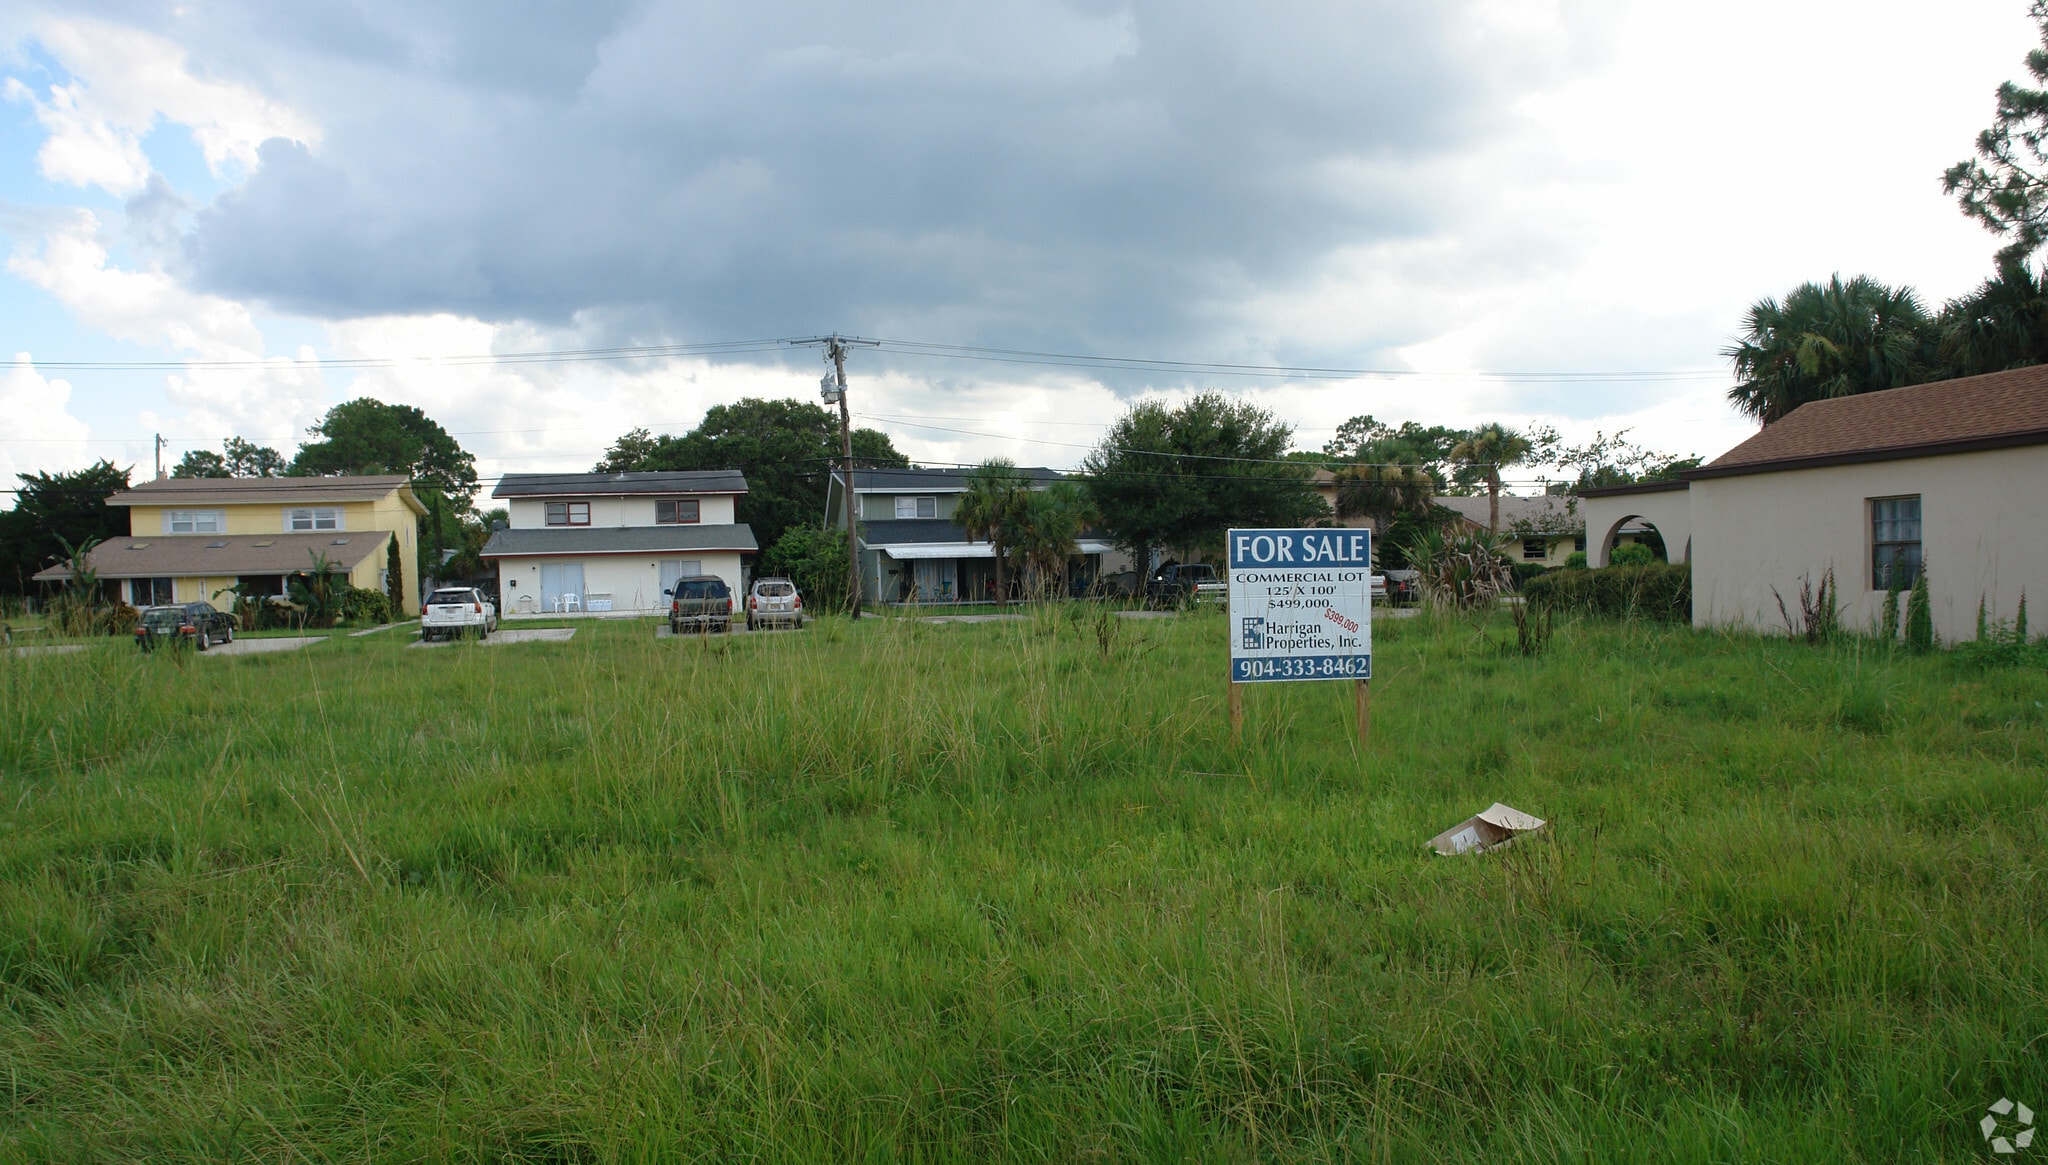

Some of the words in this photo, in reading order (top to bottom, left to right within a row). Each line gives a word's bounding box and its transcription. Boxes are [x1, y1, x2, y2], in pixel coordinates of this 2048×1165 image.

[1236, 535, 1294, 562] FOR
[1302, 535, 1363, 562] SALE
[1236, 572, 1333, 583] COMMERCIAL
[1338, 572, 1365, 582] LOT
[1266, 586, 1293, 596] 125'
[1296, 586, 1305, 595] X
[1311, 585, 1337, 595] 100'
[1268, 599, 1334, 609] $499,000.
[1324, 608, 1359, 634] $399,000
[1266, 621, 1321, 638] Harrigan
[1266, 635, 1335, 651] Properties,
[1339, 635, 1362, 648] Inc.
[1240, 657, 1367, 678] 904-333-8462
